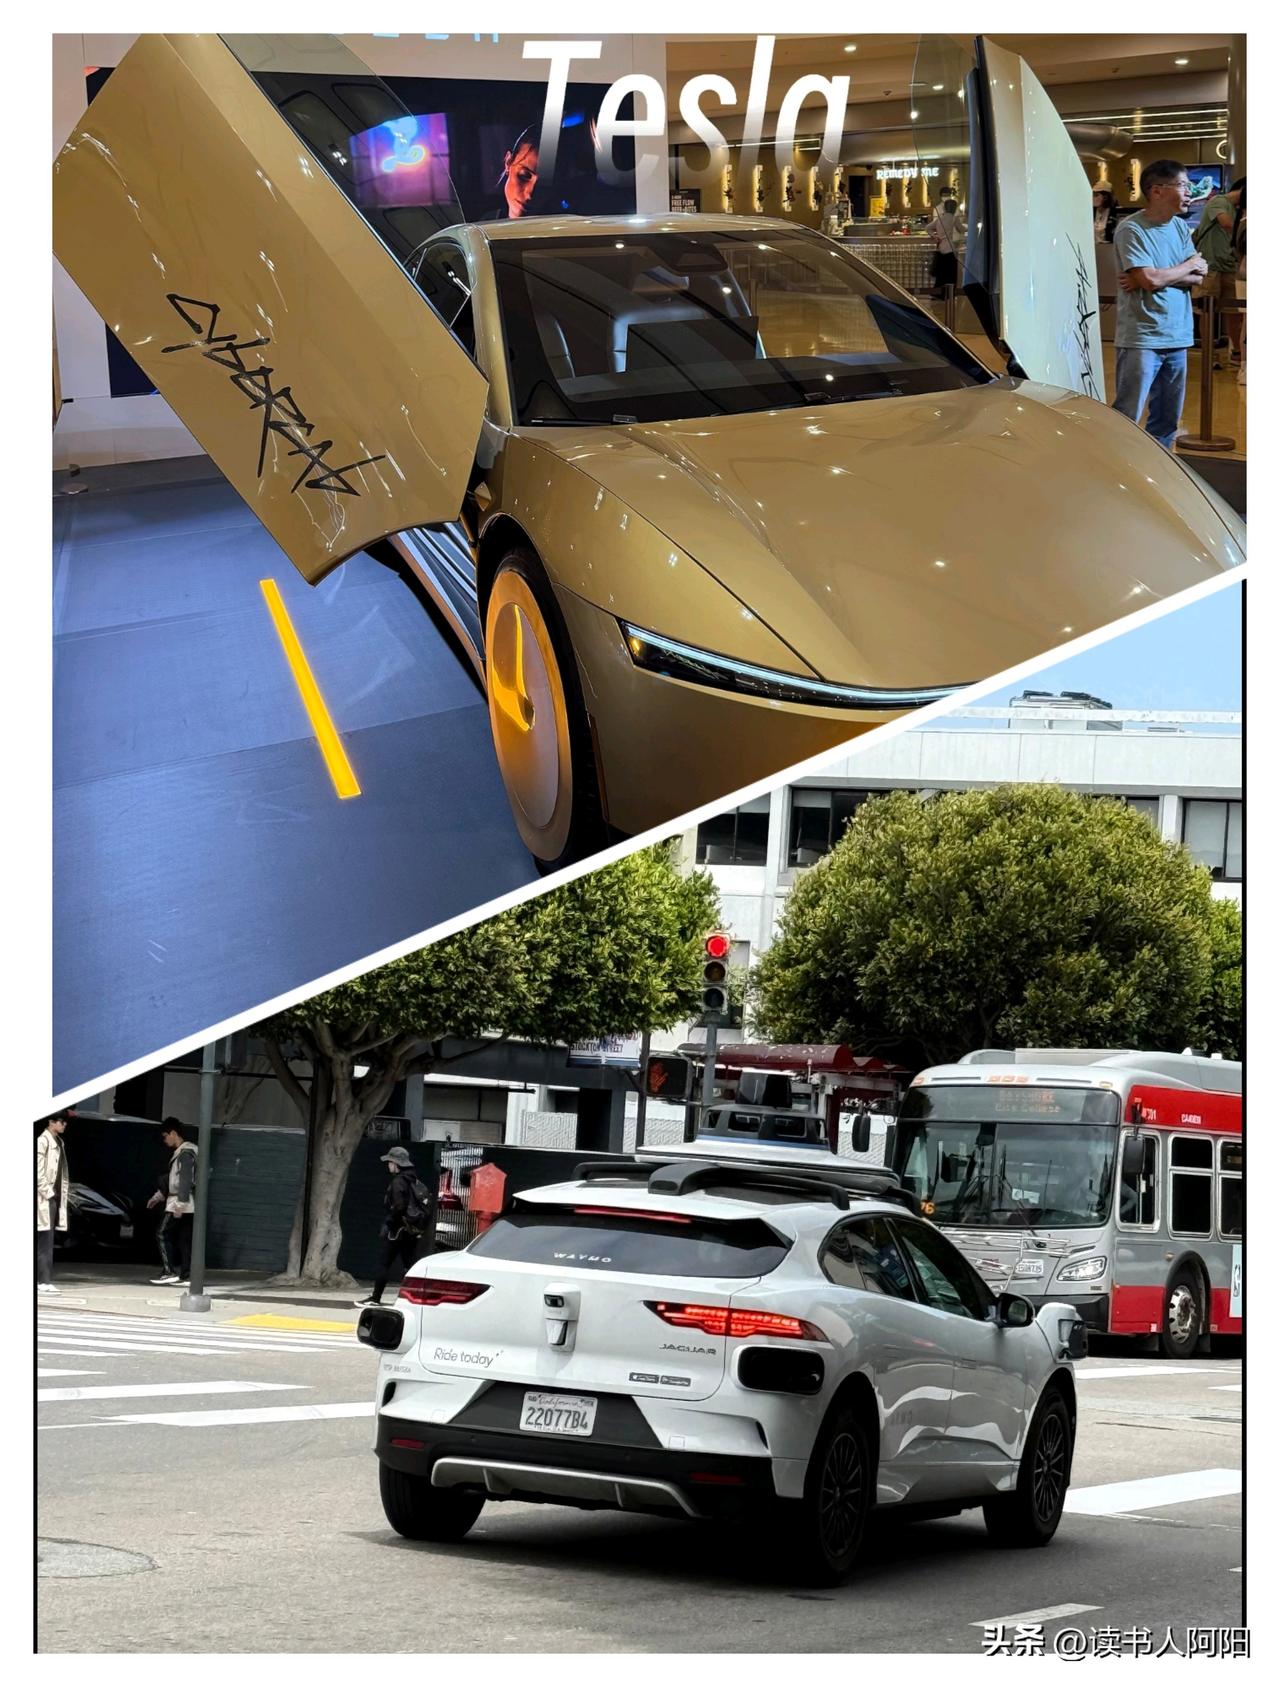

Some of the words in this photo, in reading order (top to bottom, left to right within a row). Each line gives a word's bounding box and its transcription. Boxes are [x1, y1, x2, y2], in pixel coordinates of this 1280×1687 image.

[876, 167, 918, 180] REMEDY
[554, 1252, 612, 1263] WAYMO
[658, 1343, 717, 1355] JAGUAR
[433, 1347, 457, 1362] Ride
[460, 1350, 494, 1369] today
[525, 1406, 589, 1430] 22077B4
